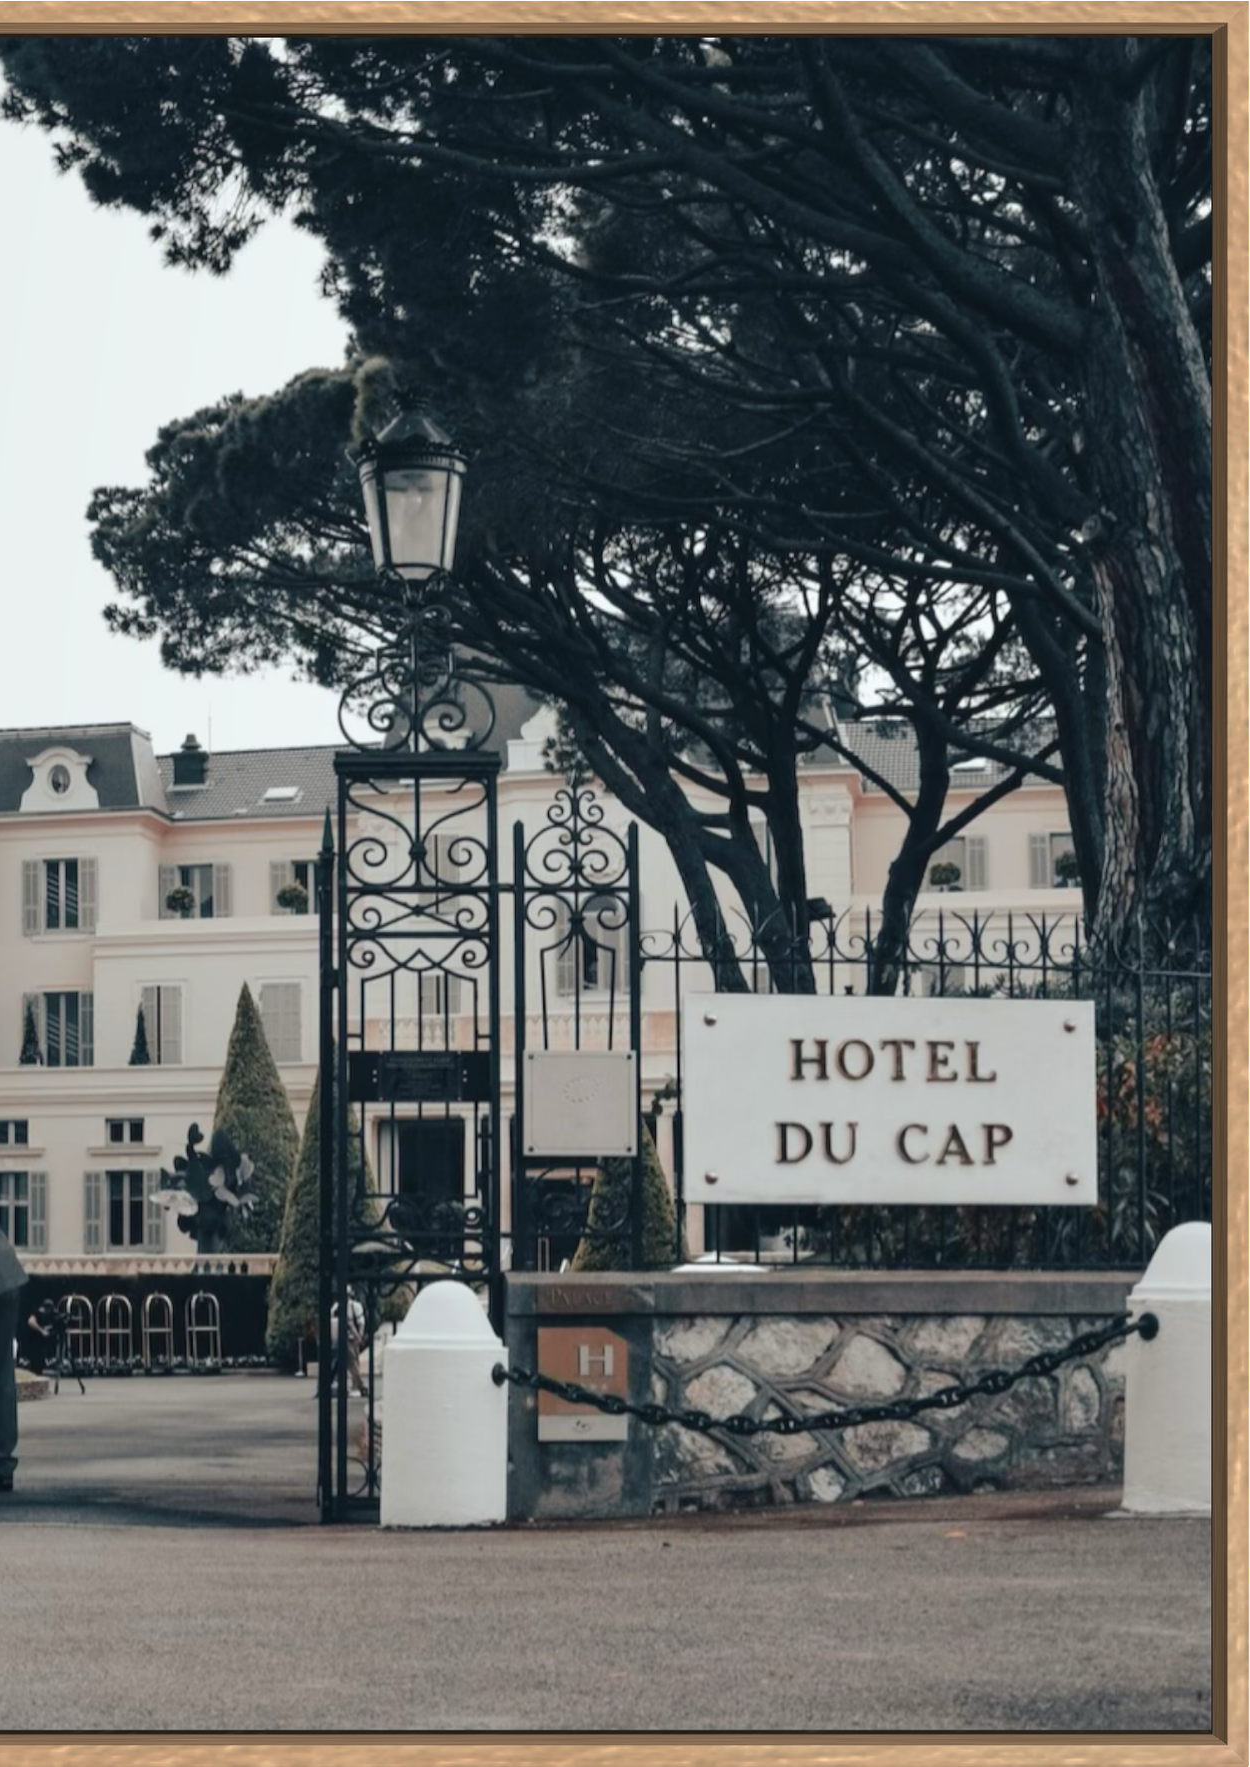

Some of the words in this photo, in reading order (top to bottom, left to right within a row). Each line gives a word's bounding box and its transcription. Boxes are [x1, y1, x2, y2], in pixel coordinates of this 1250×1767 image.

[789, 1038, 998, 1083] HOTEL
[774, 1121, 859, 1165] DU
[895, 1122, 1014, 1166] CAP
[578, 1344, 614, 1377] H
